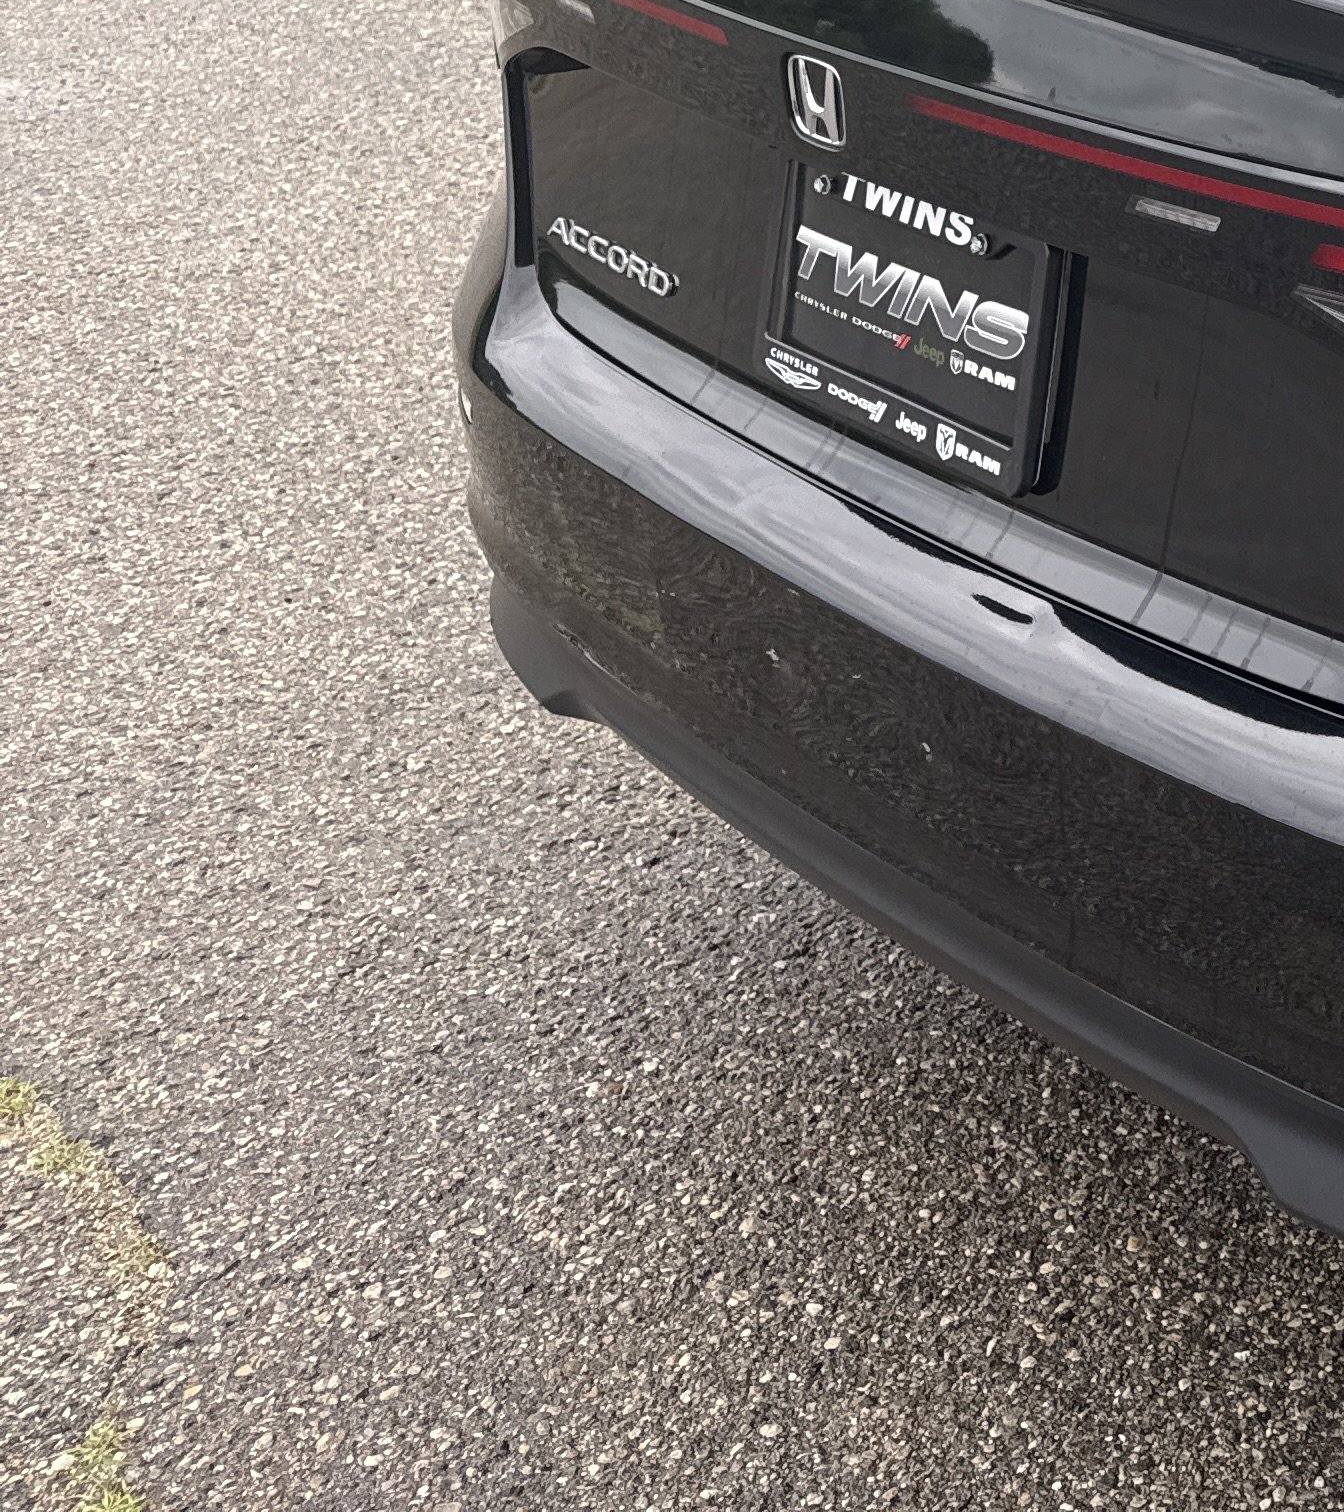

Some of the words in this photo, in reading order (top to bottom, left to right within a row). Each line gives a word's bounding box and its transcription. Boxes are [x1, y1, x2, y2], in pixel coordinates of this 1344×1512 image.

[547, 216, 674, 297] ACCORD
[841, 171, 975, 247] TWINS
[793, 291, 849, 321] CHRYSLER
[851, 316, 902, 343] DODGE
[913, 338, 945, 367] Jeep
[963, 358, 1016, 391] RAM
[796, 224, 1030, 361] TWINS
[770, 346, 820, 377] CHRYSLER
[827, 382, 881, 413] DODGE
[895, 411, 927, 443] Jeep
[955, 442, 1001, 476] RAM
